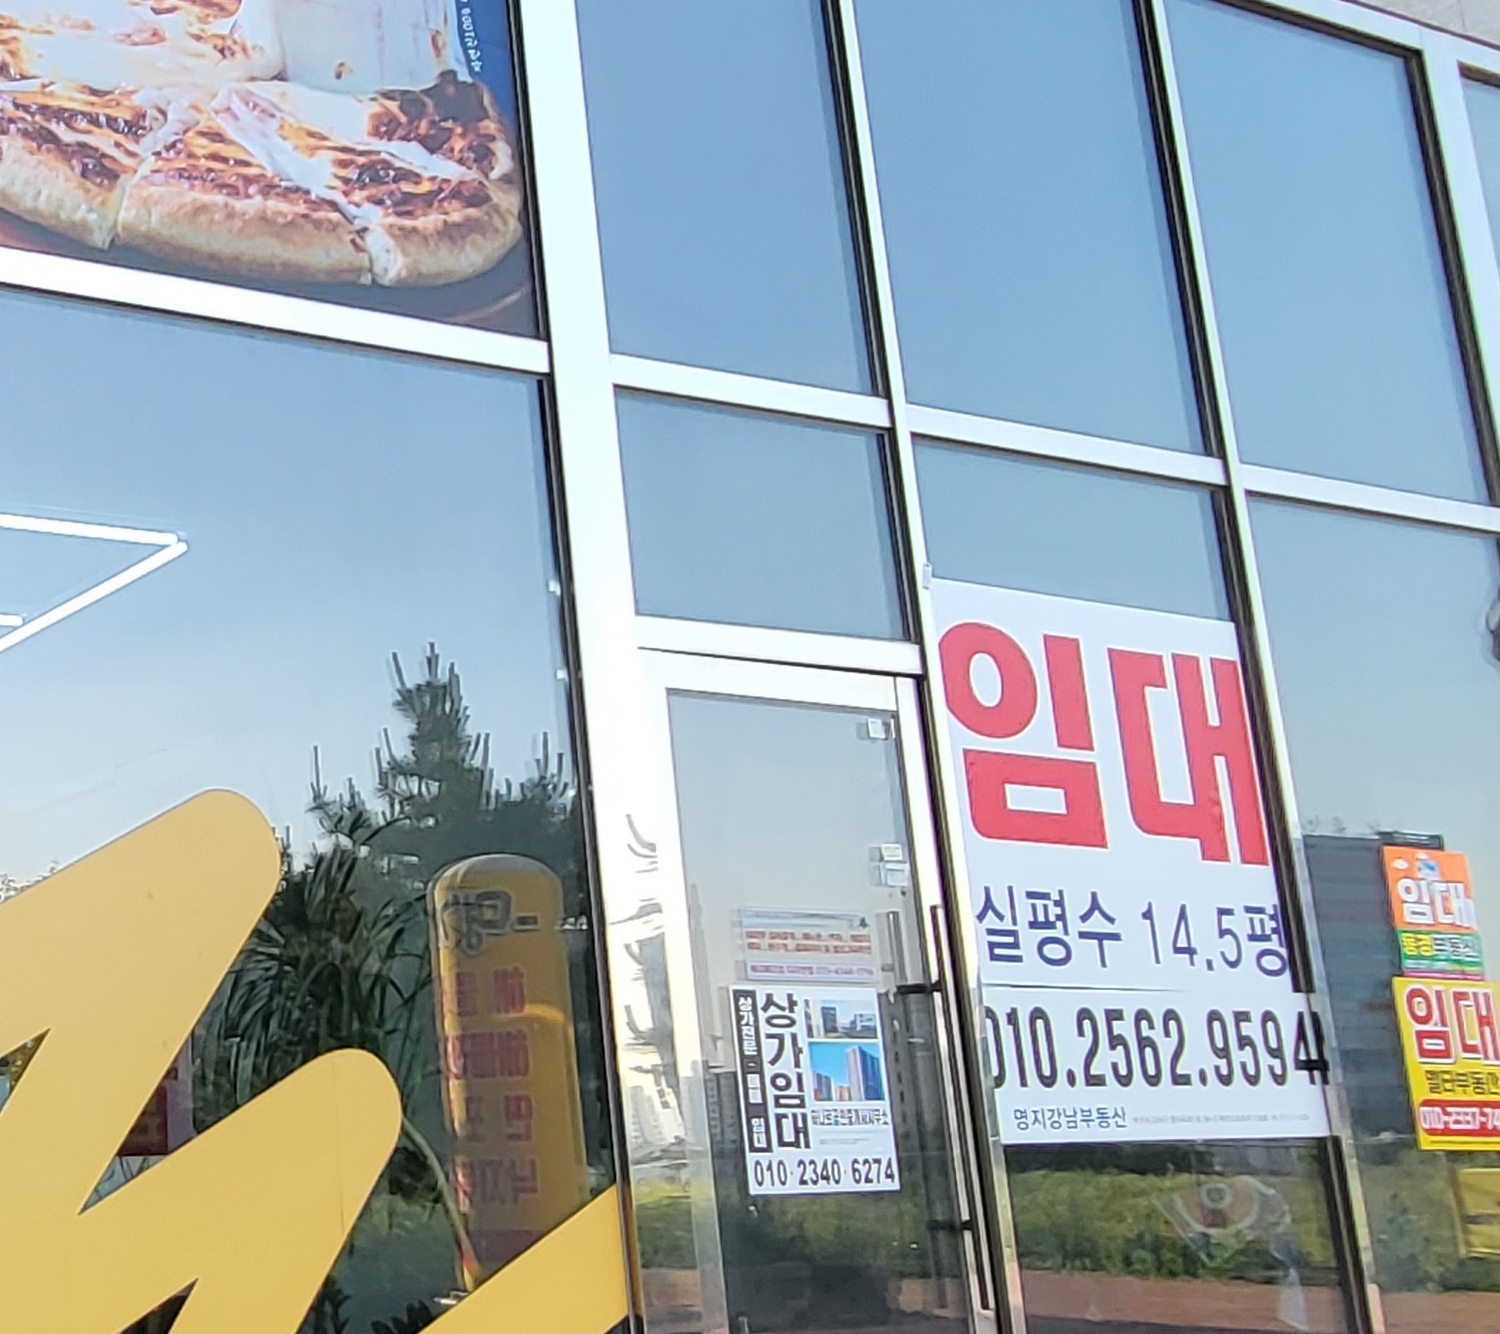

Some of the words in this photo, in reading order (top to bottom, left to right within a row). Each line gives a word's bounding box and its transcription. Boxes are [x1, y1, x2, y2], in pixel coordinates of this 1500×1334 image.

[938, 621, 1269, 866] 임대
[975, 884, 1124, 969] 실평수
[1140, 900, 1288, 978] 14.5평
[1396, 877, 1479, 928] 임대
[1404, 984, 1500, 1065] 임대
[760, 992, 812, 1150] 상가임대
[1013, 1106, 1128, 1132] 명지강남부동산
